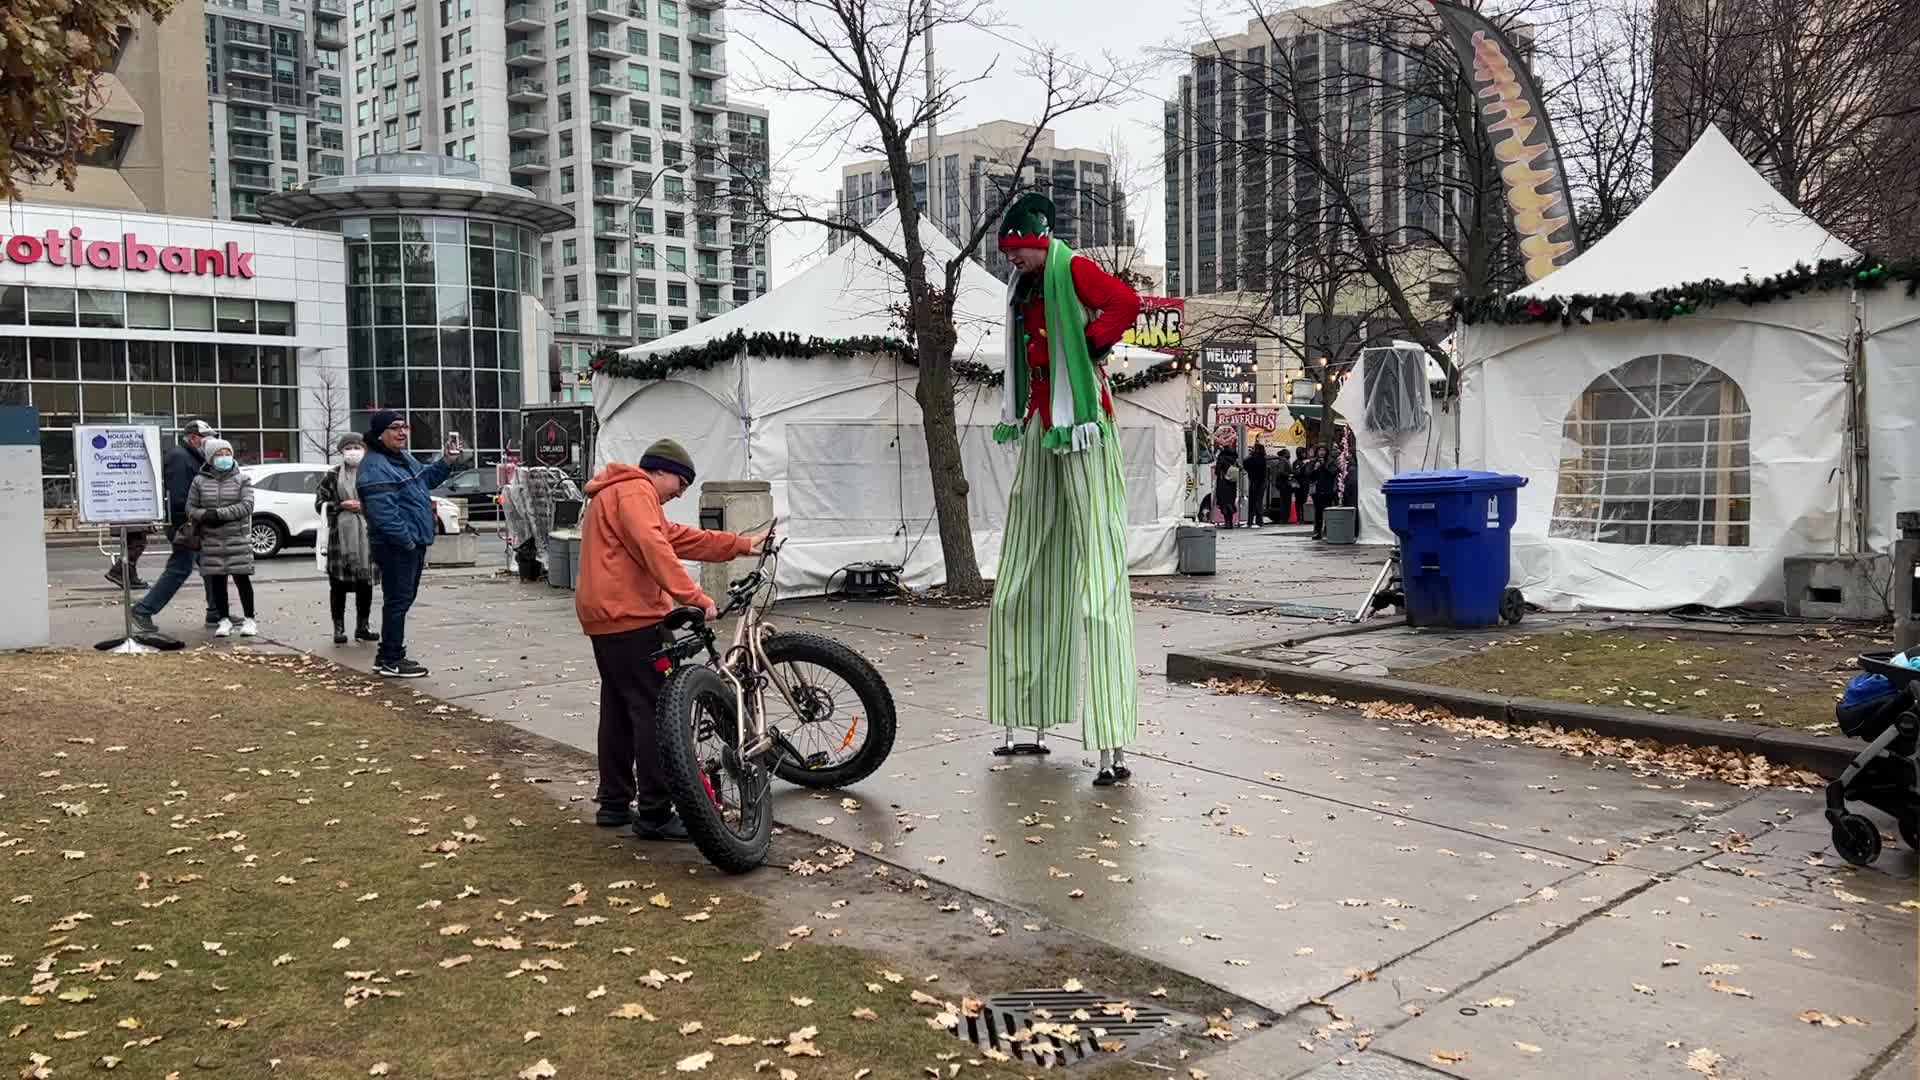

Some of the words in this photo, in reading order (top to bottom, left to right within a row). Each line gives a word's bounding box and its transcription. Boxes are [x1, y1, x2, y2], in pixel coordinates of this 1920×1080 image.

[0, 226, 256, 279] otiabank
[1206, 347, 1253, 364] WELCOME
[1223, 363, 1237, 378] TO
